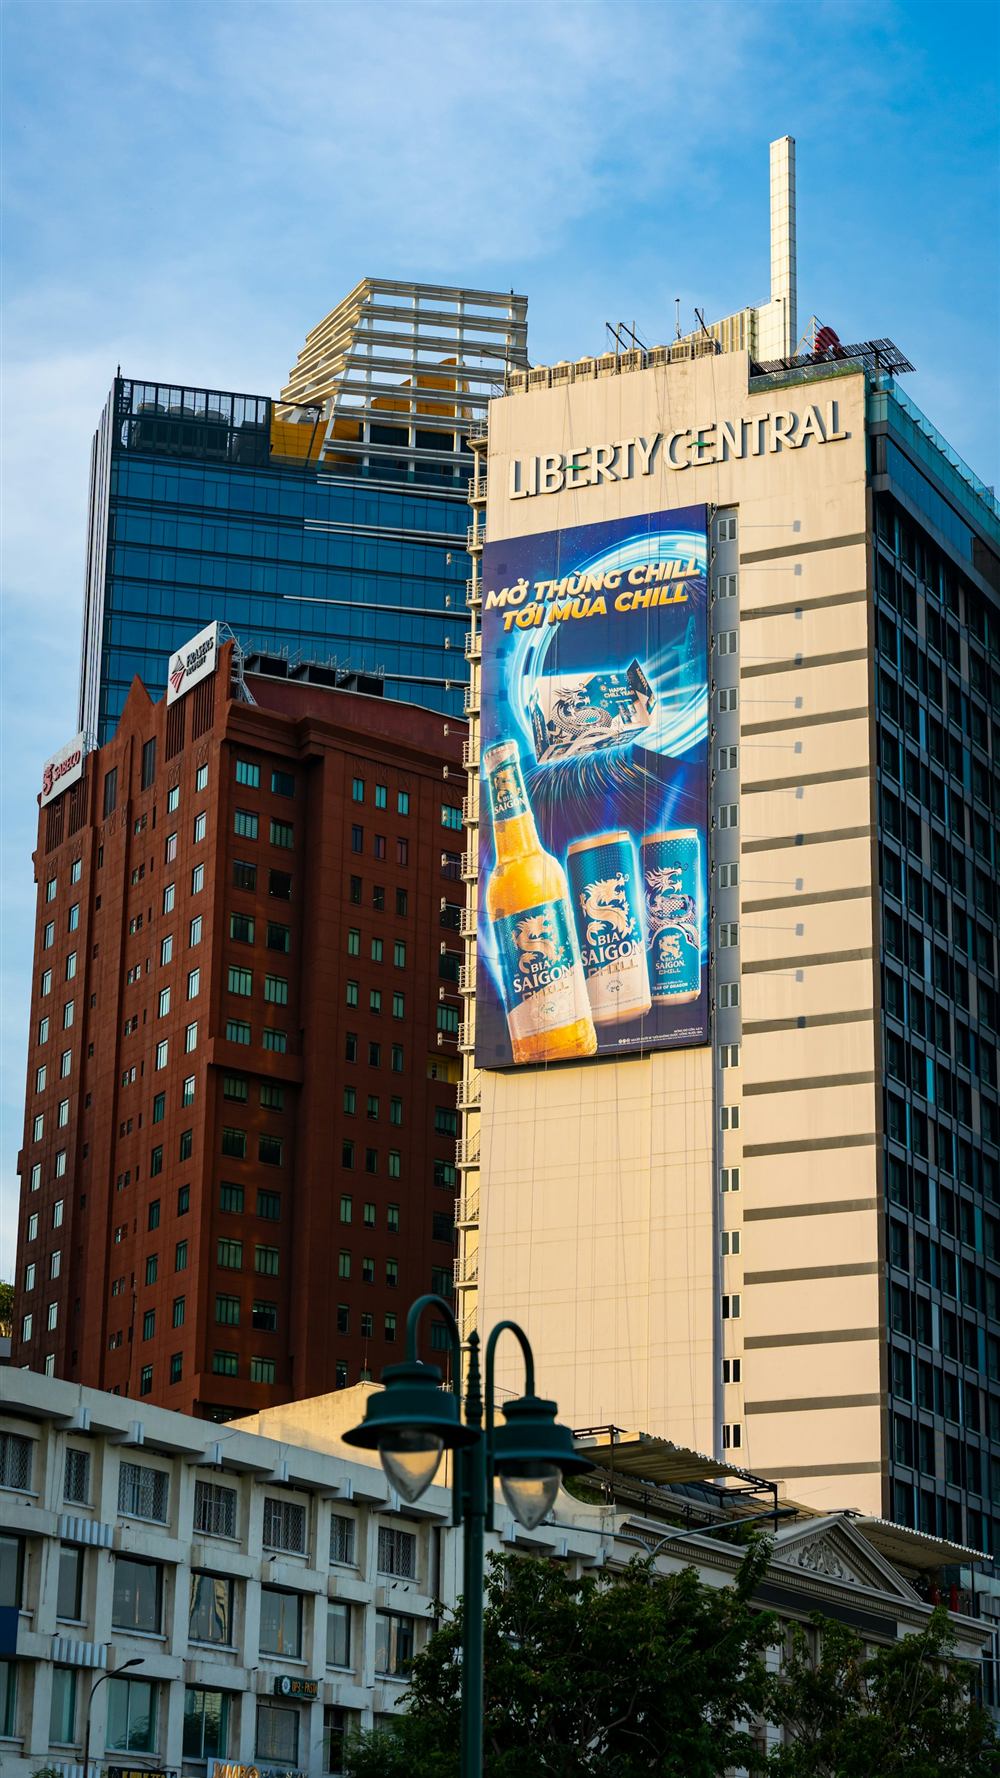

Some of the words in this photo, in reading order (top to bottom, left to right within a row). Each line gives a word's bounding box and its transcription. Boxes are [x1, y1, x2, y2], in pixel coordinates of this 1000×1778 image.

[509, 433, 661, 500] LIBERTY
[663, 400, 849, 471] CENTRAL
[484, 577, 531, 610] MỞ
[534, 570, 622, 602] THÙNG
[628, 557, 701, 585] CHILL
[502, 601, 546, 631] TỚI
[548, 596, 608, 622] MÙA
[614, 582, 689, 612] CHILL
[581, 938, 643, 967] SAIGON
[597, 931, 621, 946] BIA
[513, 963, 575, 993] SAIGON
[530, 959, 552, 973] BIA
[655, 959, 686, 970] SAIGON
